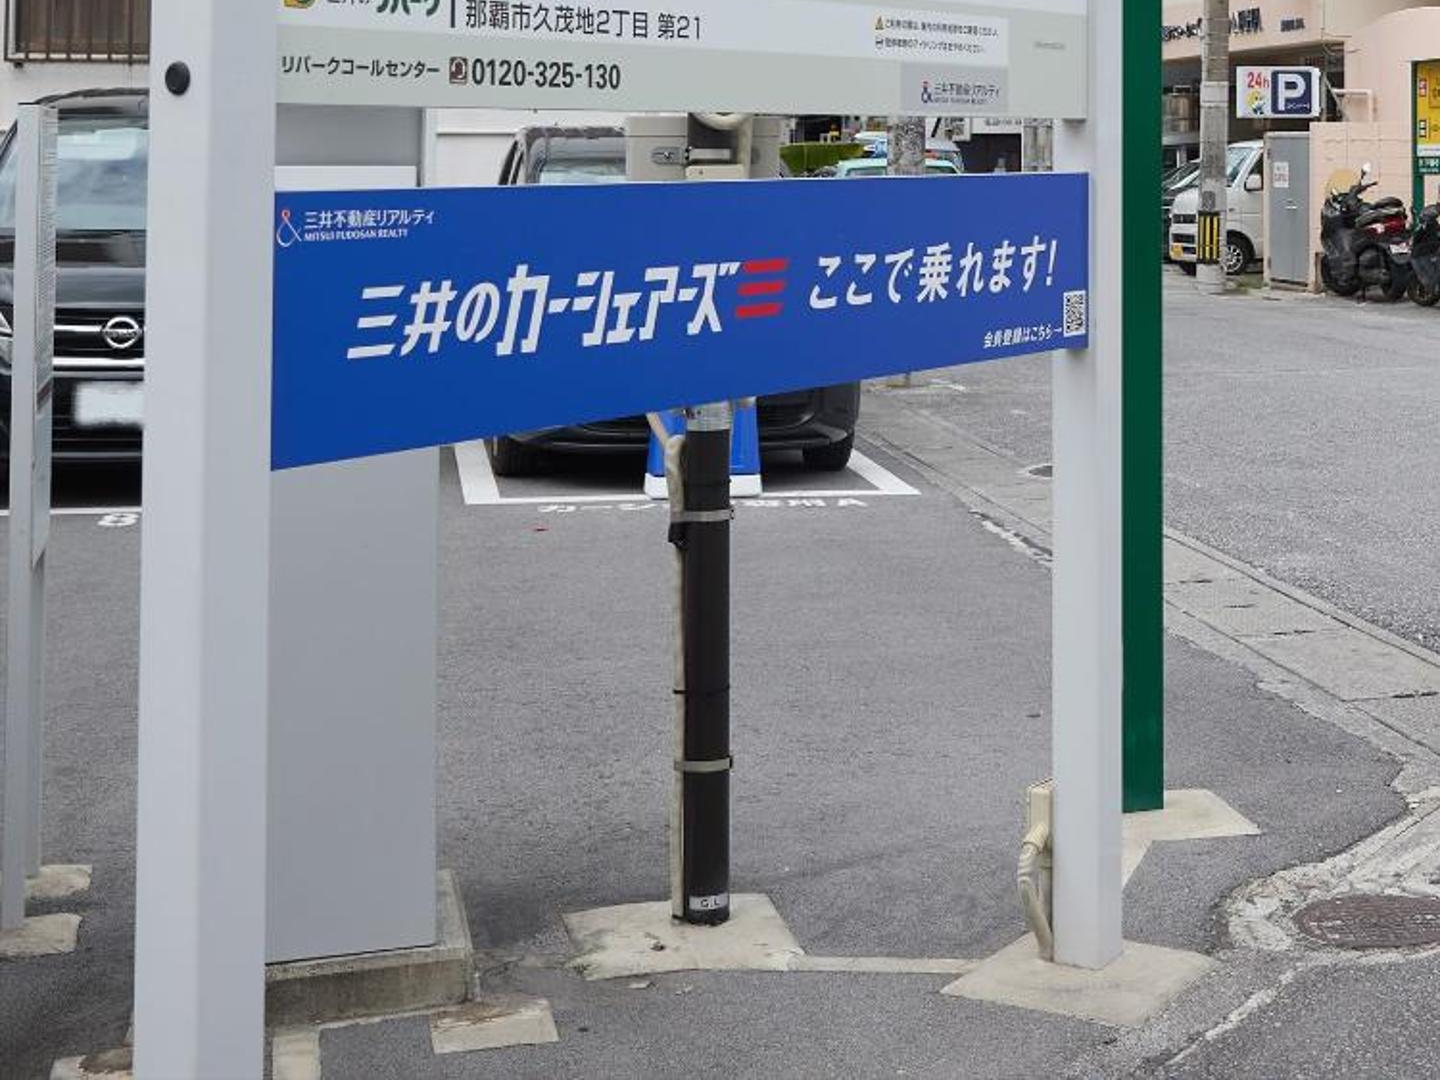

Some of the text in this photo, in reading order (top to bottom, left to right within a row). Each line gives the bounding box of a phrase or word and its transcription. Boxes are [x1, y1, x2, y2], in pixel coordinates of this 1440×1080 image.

[657, 12, 701, 40] 第21
[281, 55, 621, 91] リパークコールセンター 0120-325-130
[1247, 71, 1270, 89] 24h
[1277, 73, 1306, 111] P
[304, 209, 435, 230] 三井不動産リアルティ
[304, 230, 335, 242] MITSUI
[808, 234, 1058, 311] ここで乗れます!
[346, 262, 741, 360] 三井のカーシェアーズ
